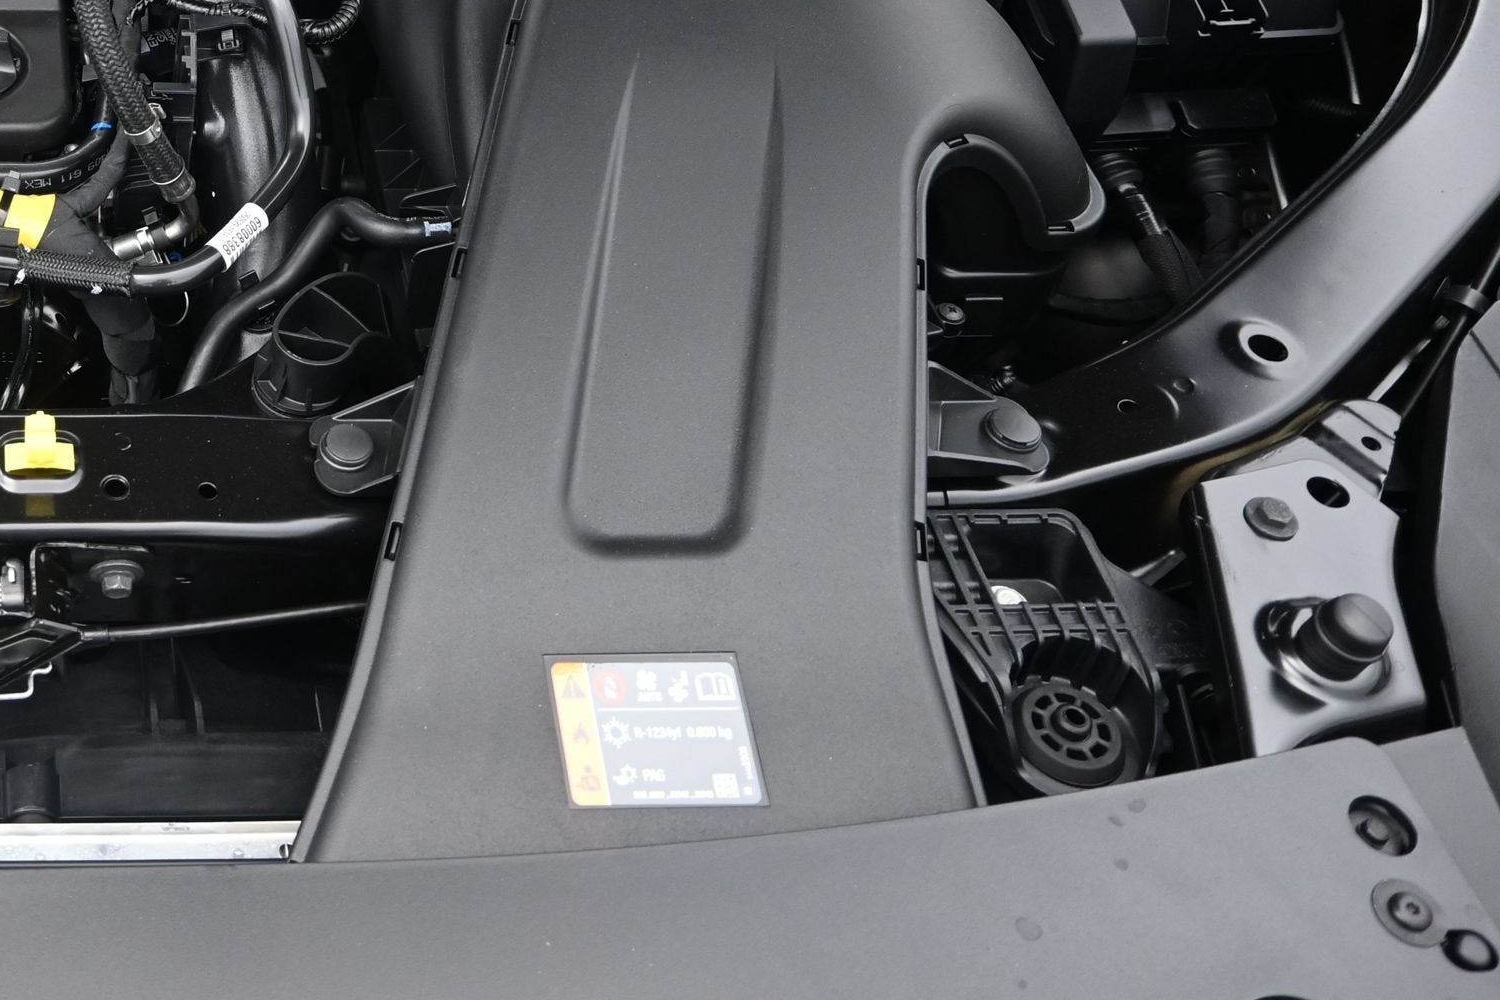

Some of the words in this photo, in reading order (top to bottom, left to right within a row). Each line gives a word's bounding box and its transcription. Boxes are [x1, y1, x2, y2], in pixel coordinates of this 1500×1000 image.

[24, 178, 52, 189] MEX
[59, 169, 82, 184] 611
[718, 726, 733, 741] kg
[642, 768, 666, 782] PAG
